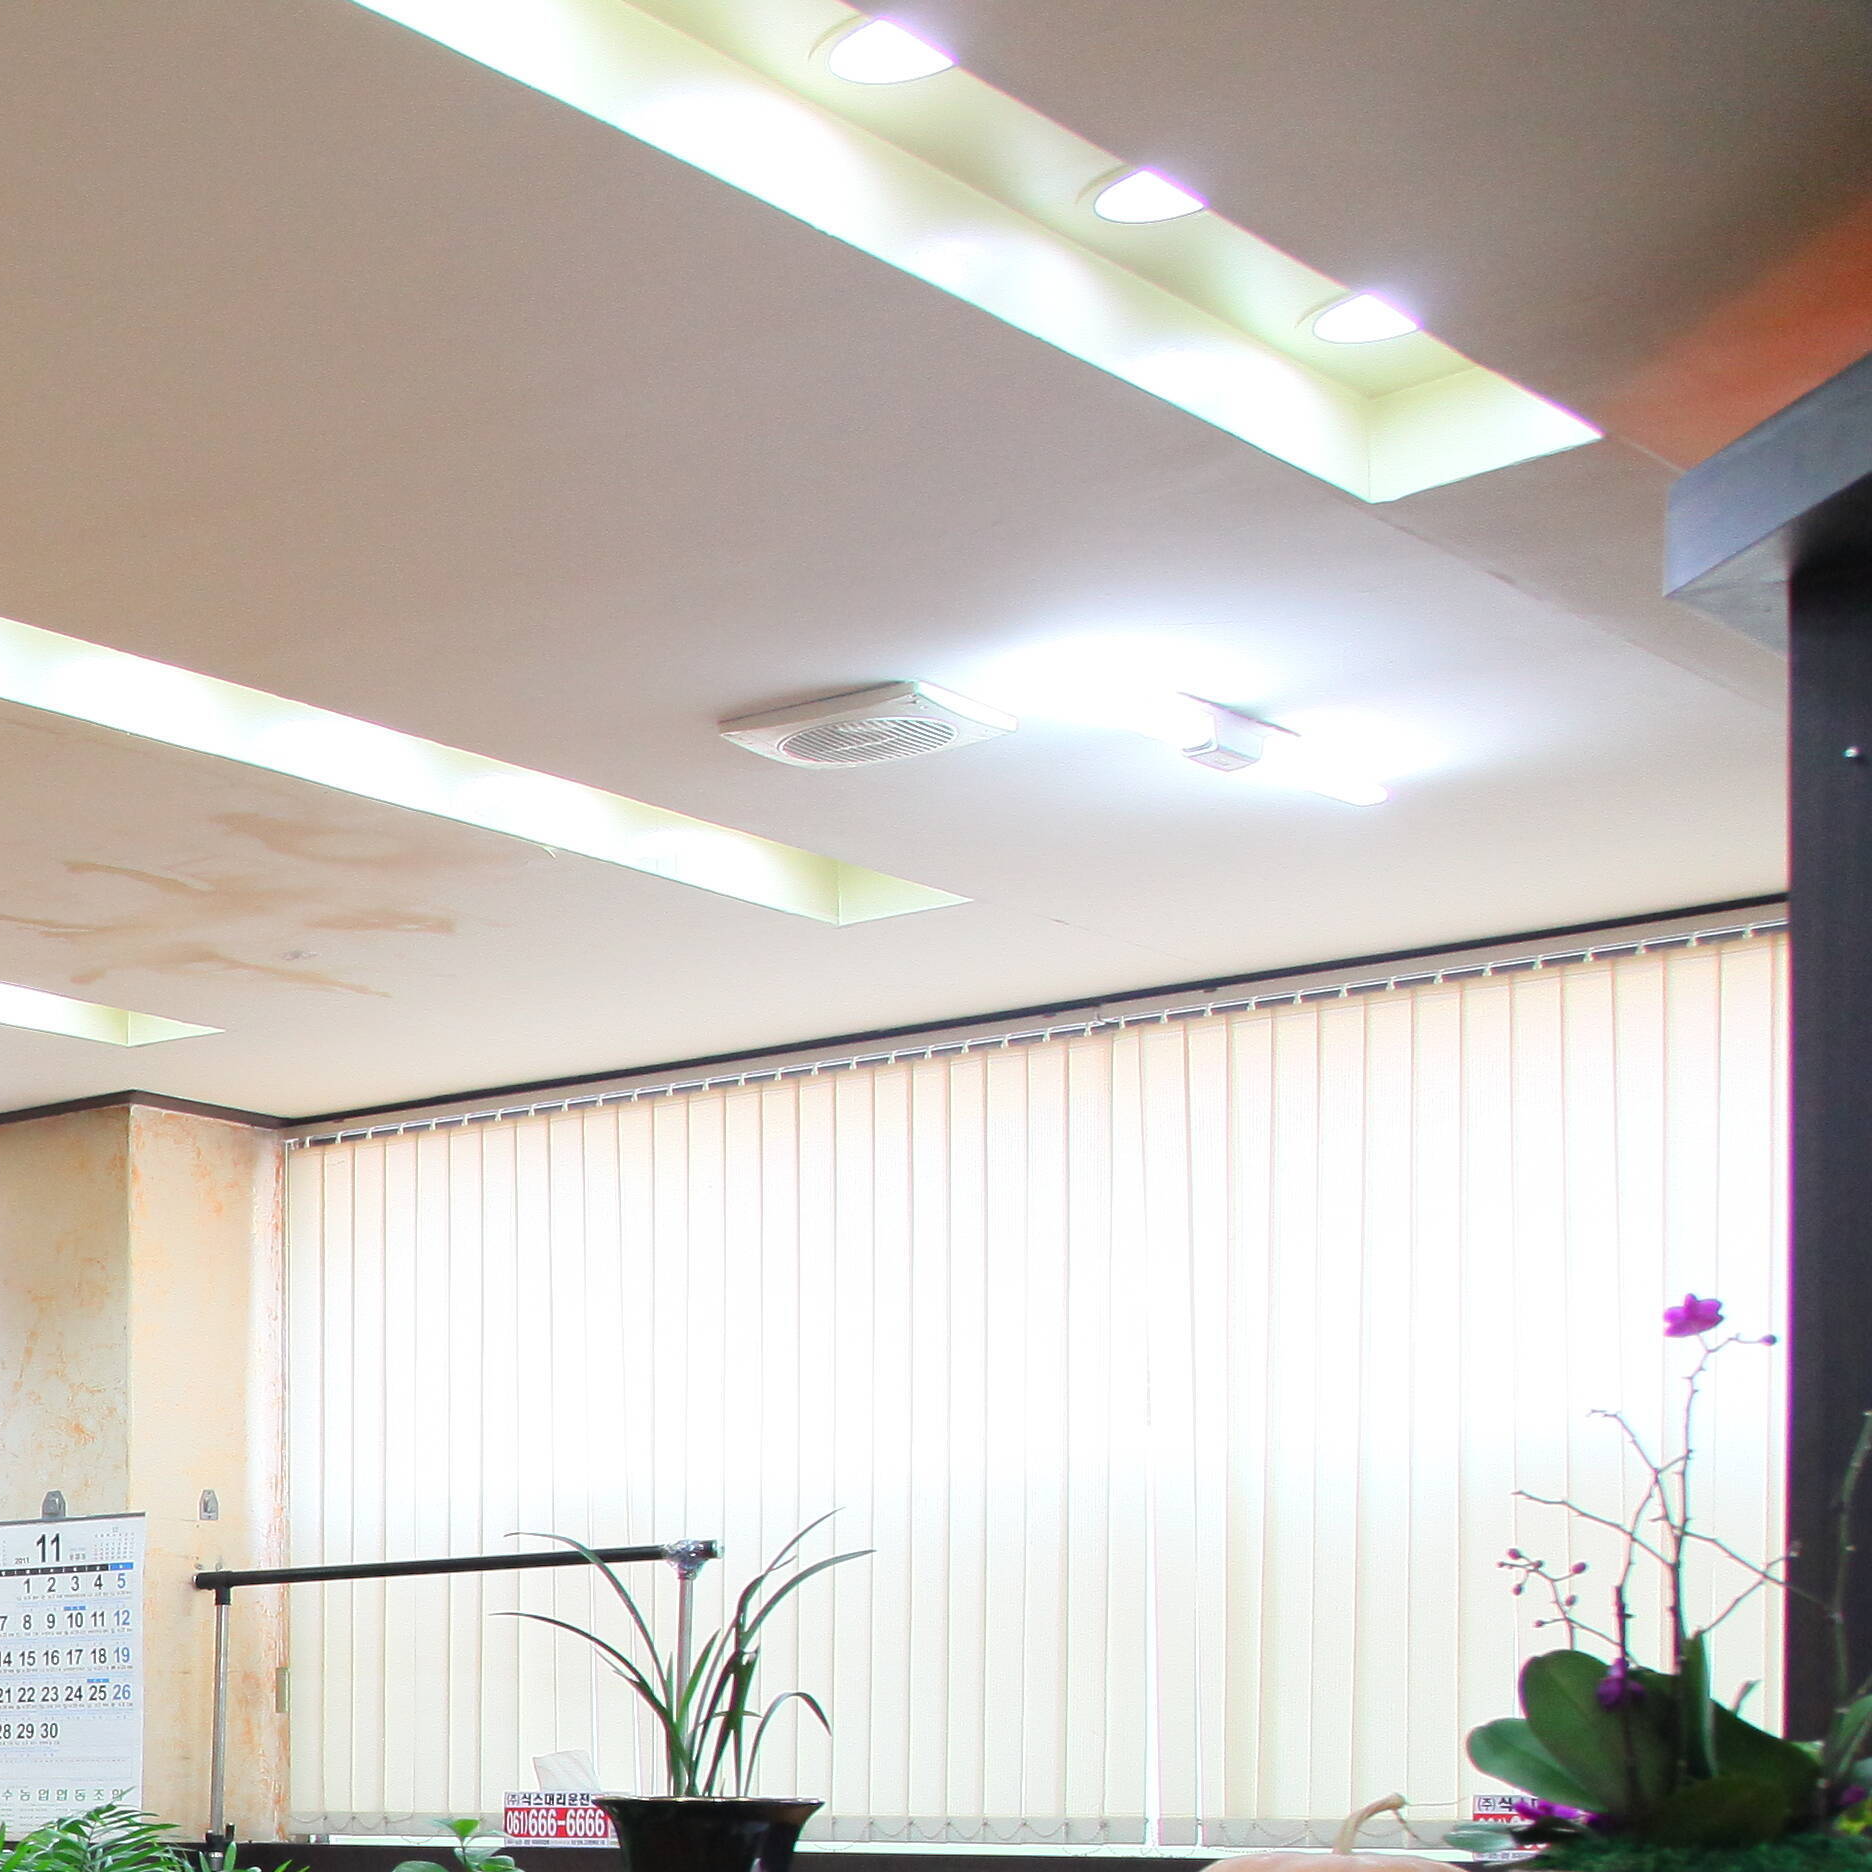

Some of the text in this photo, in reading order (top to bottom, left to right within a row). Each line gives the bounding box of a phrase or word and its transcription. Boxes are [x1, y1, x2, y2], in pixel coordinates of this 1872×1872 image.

[36, 1533, 61, 1563] 11
[24, 1573, 126, 1594] 1 2 3 4 5
[0, 1616, 8, 1631] 7
[23, 1615, 32, 1630] 8
[46, 1614, 56, 1629] 9
[67, 1612, 84, 1628] 10
[90, 1612, 105, 1627] 11
[114, 1610, 131, 1626] 12
[19, 1651, 36, 1667] 15
[42, 1650, 60, 1666] 16
[66, 1649, 82, 1665] 17
[90, 1648, 107, 1664] 18
[114, 1647, 131, 1663] 19
[17, 1687, 36, 1702] 22
[41, 1686, 59, 1702] 23
[65, 1685, 83, 1701] 24
[88, 1685, 107, 1700] 25
[112, 1684, 131, 1700] 26
[16, 1723, 35, 1739] 29
[40, 1722, 58, 1739] 30
